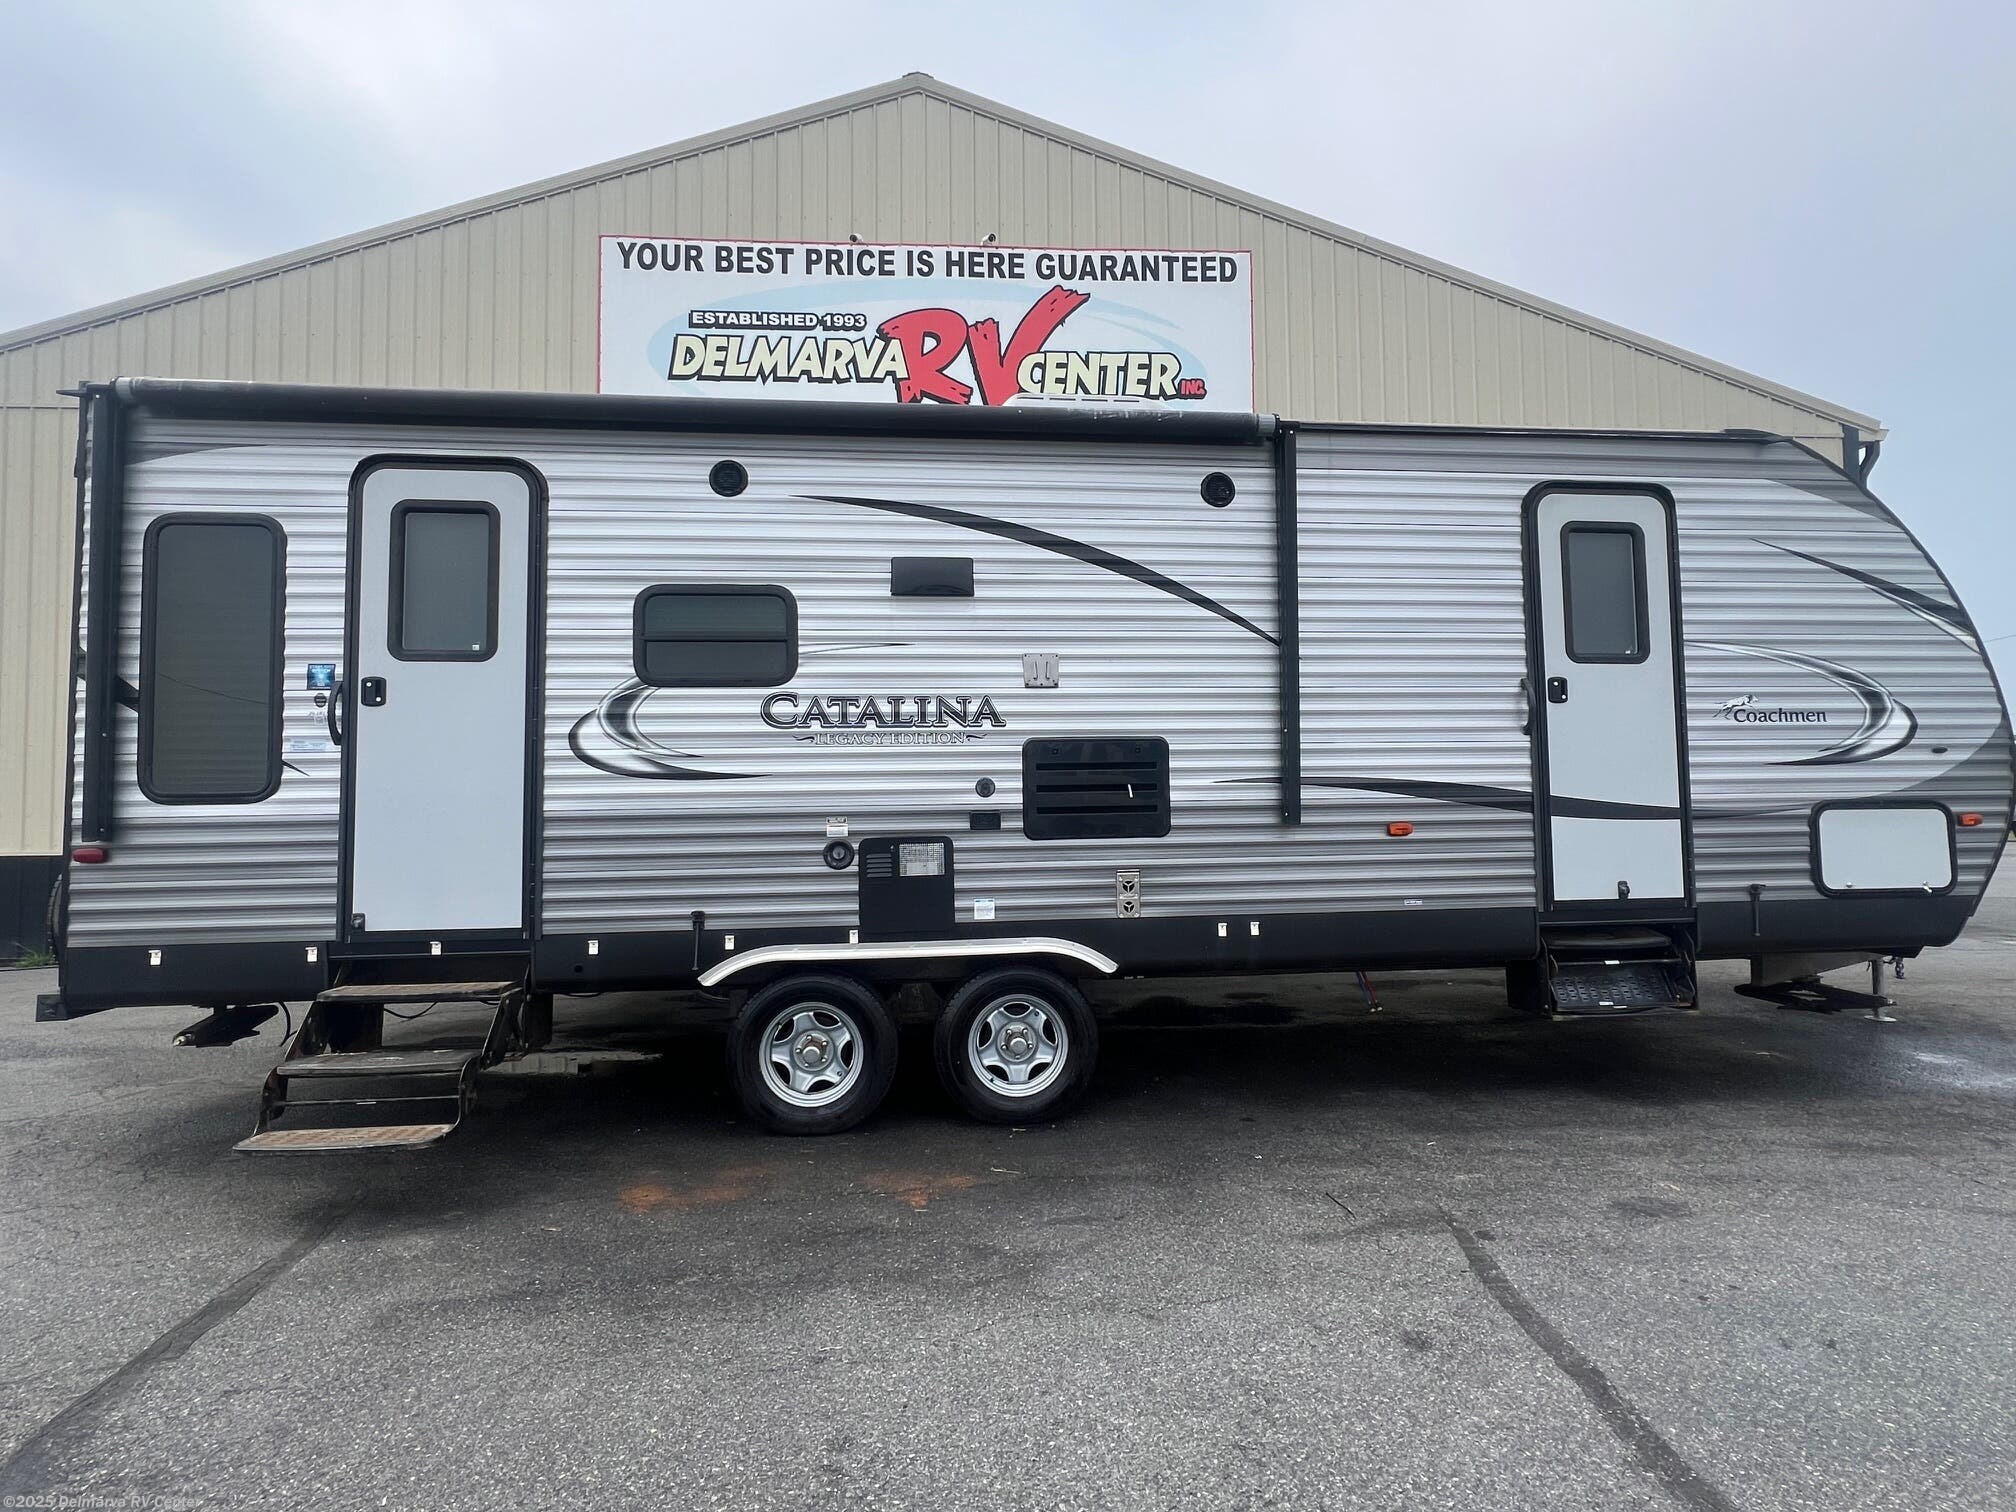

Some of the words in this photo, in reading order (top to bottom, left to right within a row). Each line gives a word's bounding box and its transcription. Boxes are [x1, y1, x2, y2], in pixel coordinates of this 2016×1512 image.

[617, 242, 704, 272] YOUR
[715, 246, 794, 274] BEST
[805, 248, 895, 277] PRICE
[906, 250, 934, 277] IS
[945, 251, 1025, 279] HERE
[1035, 253, 1238, 282] GUARANTEED
[690, 311, 818, 328] ESTABLISHED
[822, 313, 867, 329] 1993
[668, 333, 909, 384] DELMARVA
[876, 284, 1091, 406] RV
[1016, 350, 1182, 400] CENTER
[1178, 378, 1207, 399] INC.
[760, 691, 1007, 729] CATALINA
[1733, 708, 1828, 723] Coachmen
[815, 732, 884, 746] LEGACY
[890, 733, 966, 745] EDITION
